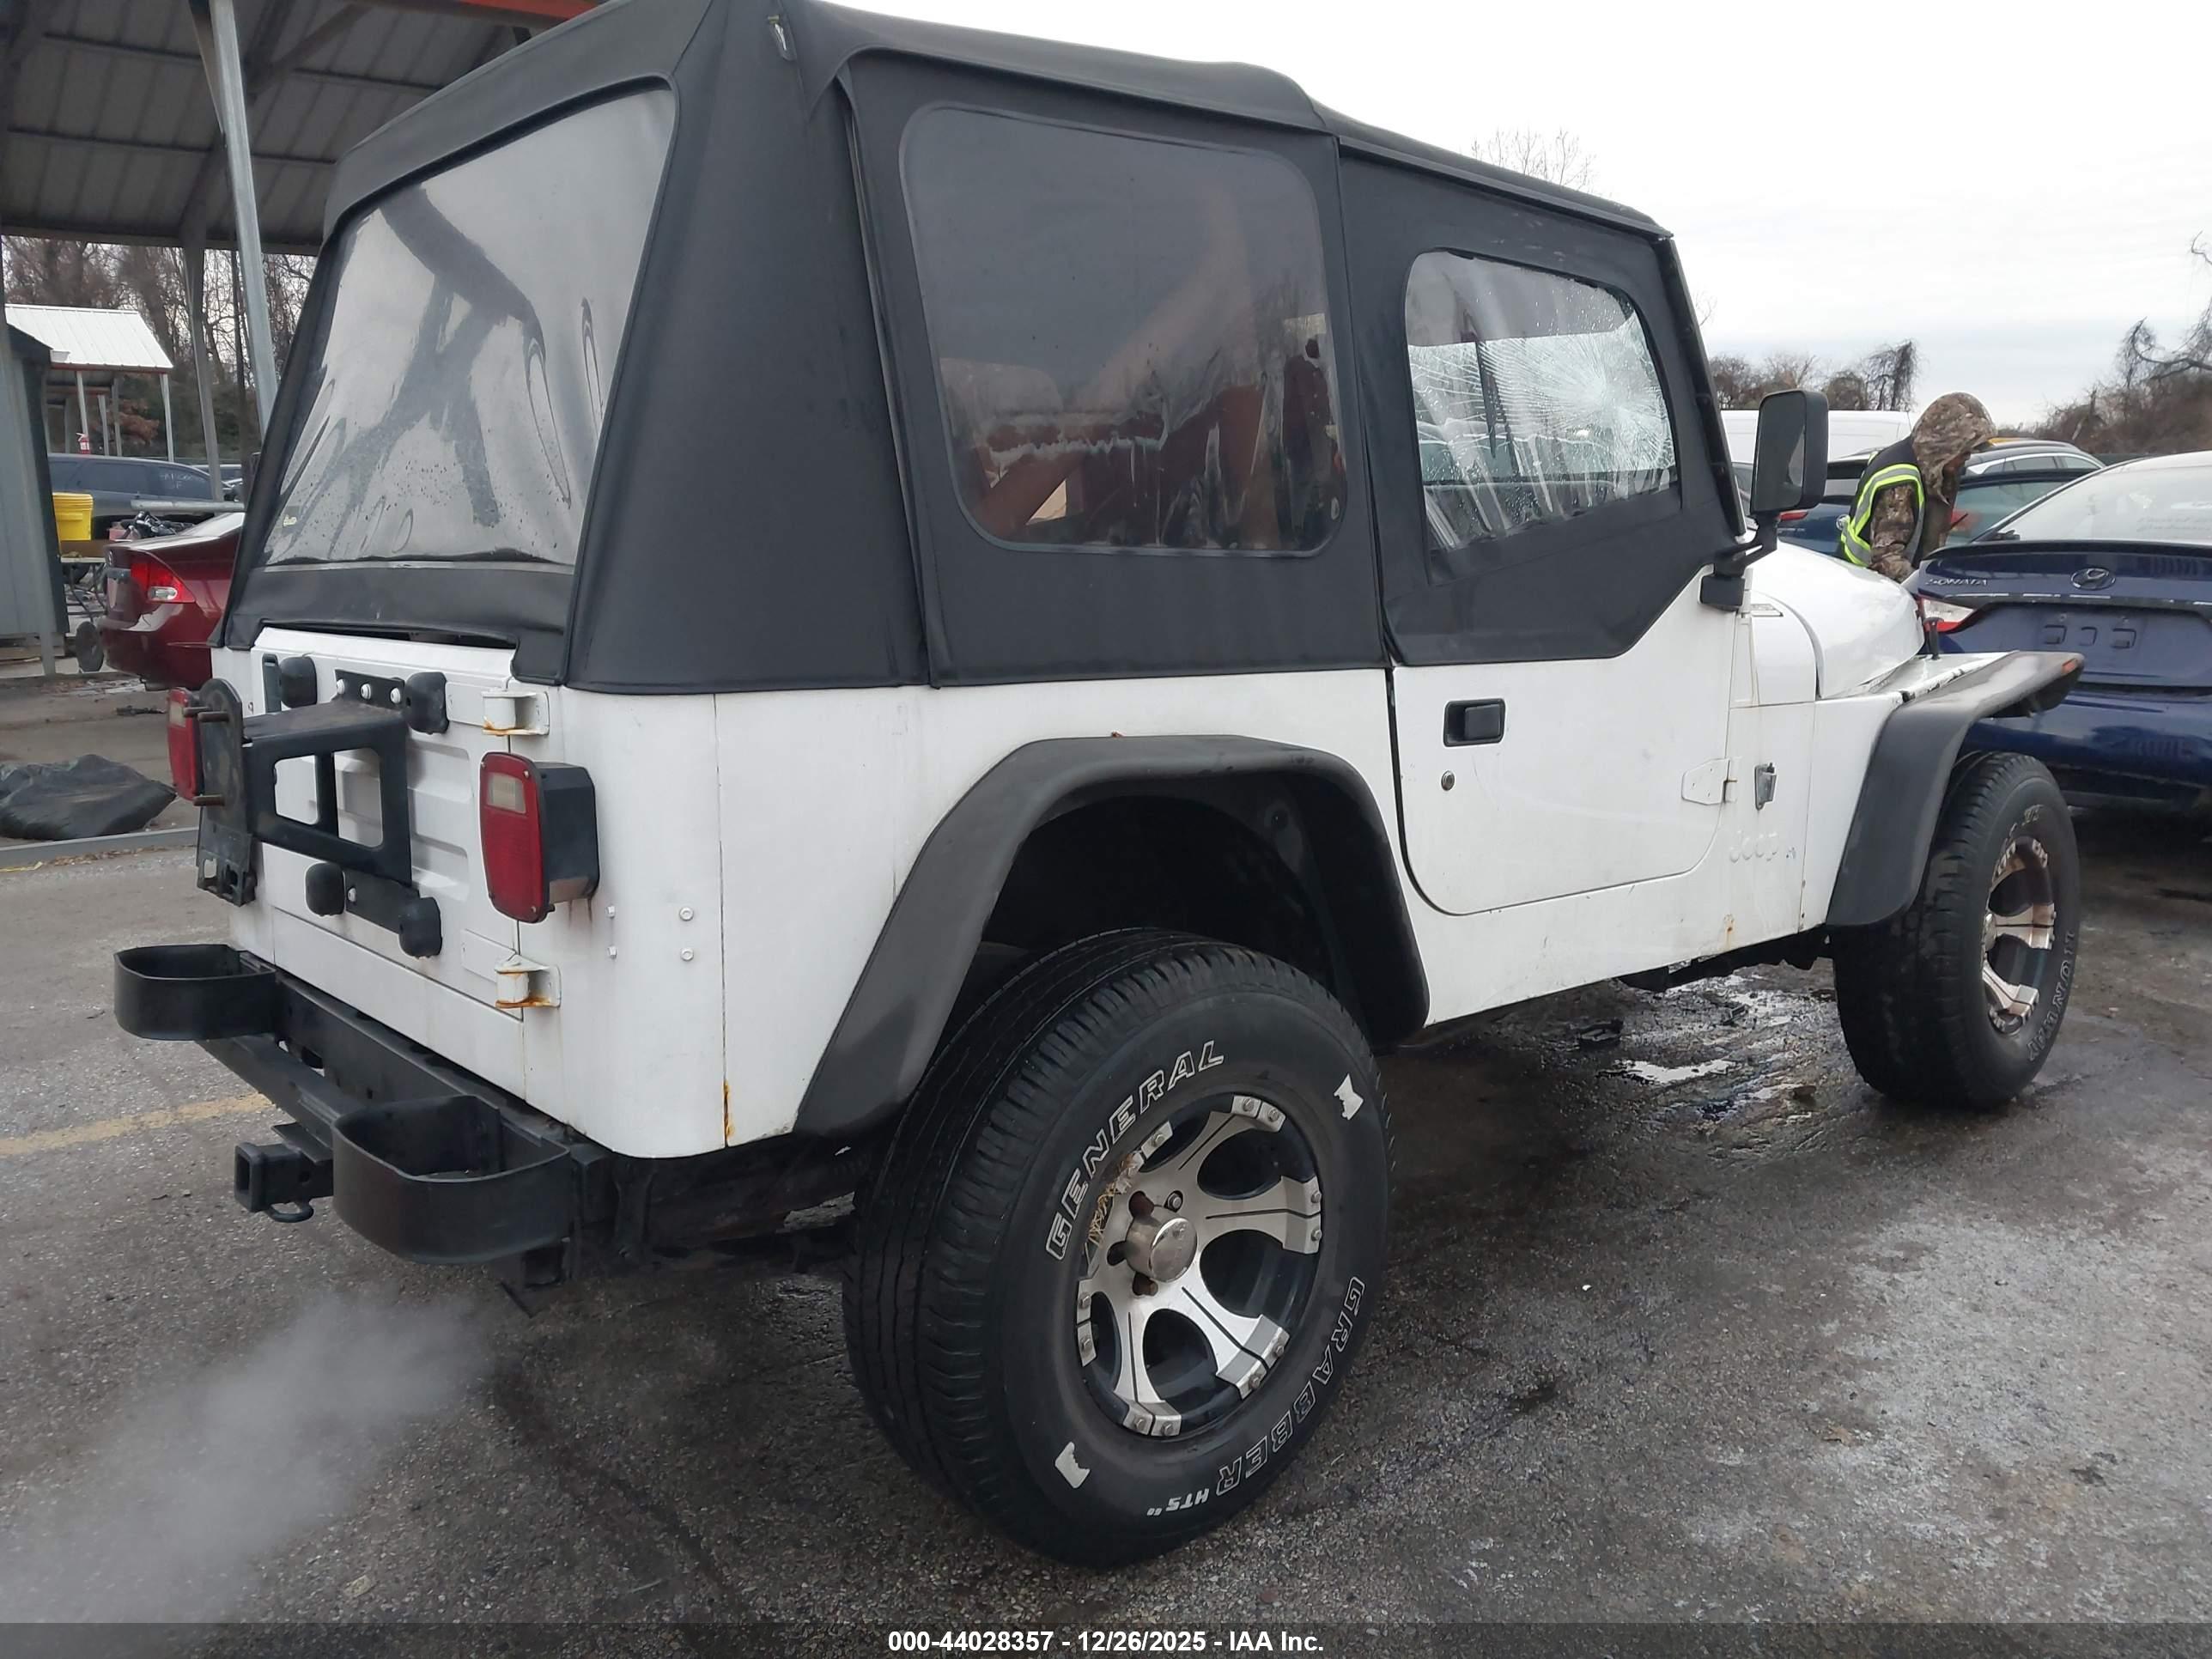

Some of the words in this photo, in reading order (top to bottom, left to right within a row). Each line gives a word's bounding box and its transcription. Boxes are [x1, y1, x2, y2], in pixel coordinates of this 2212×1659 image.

[1924, 577, 1988, 586] SONATA
[1045, 1040, 1224, 1261] GENERAL
[1216, 1276, 1365, 1496] GRABBER
[1165, 1488, 1210, 1512] HTS
